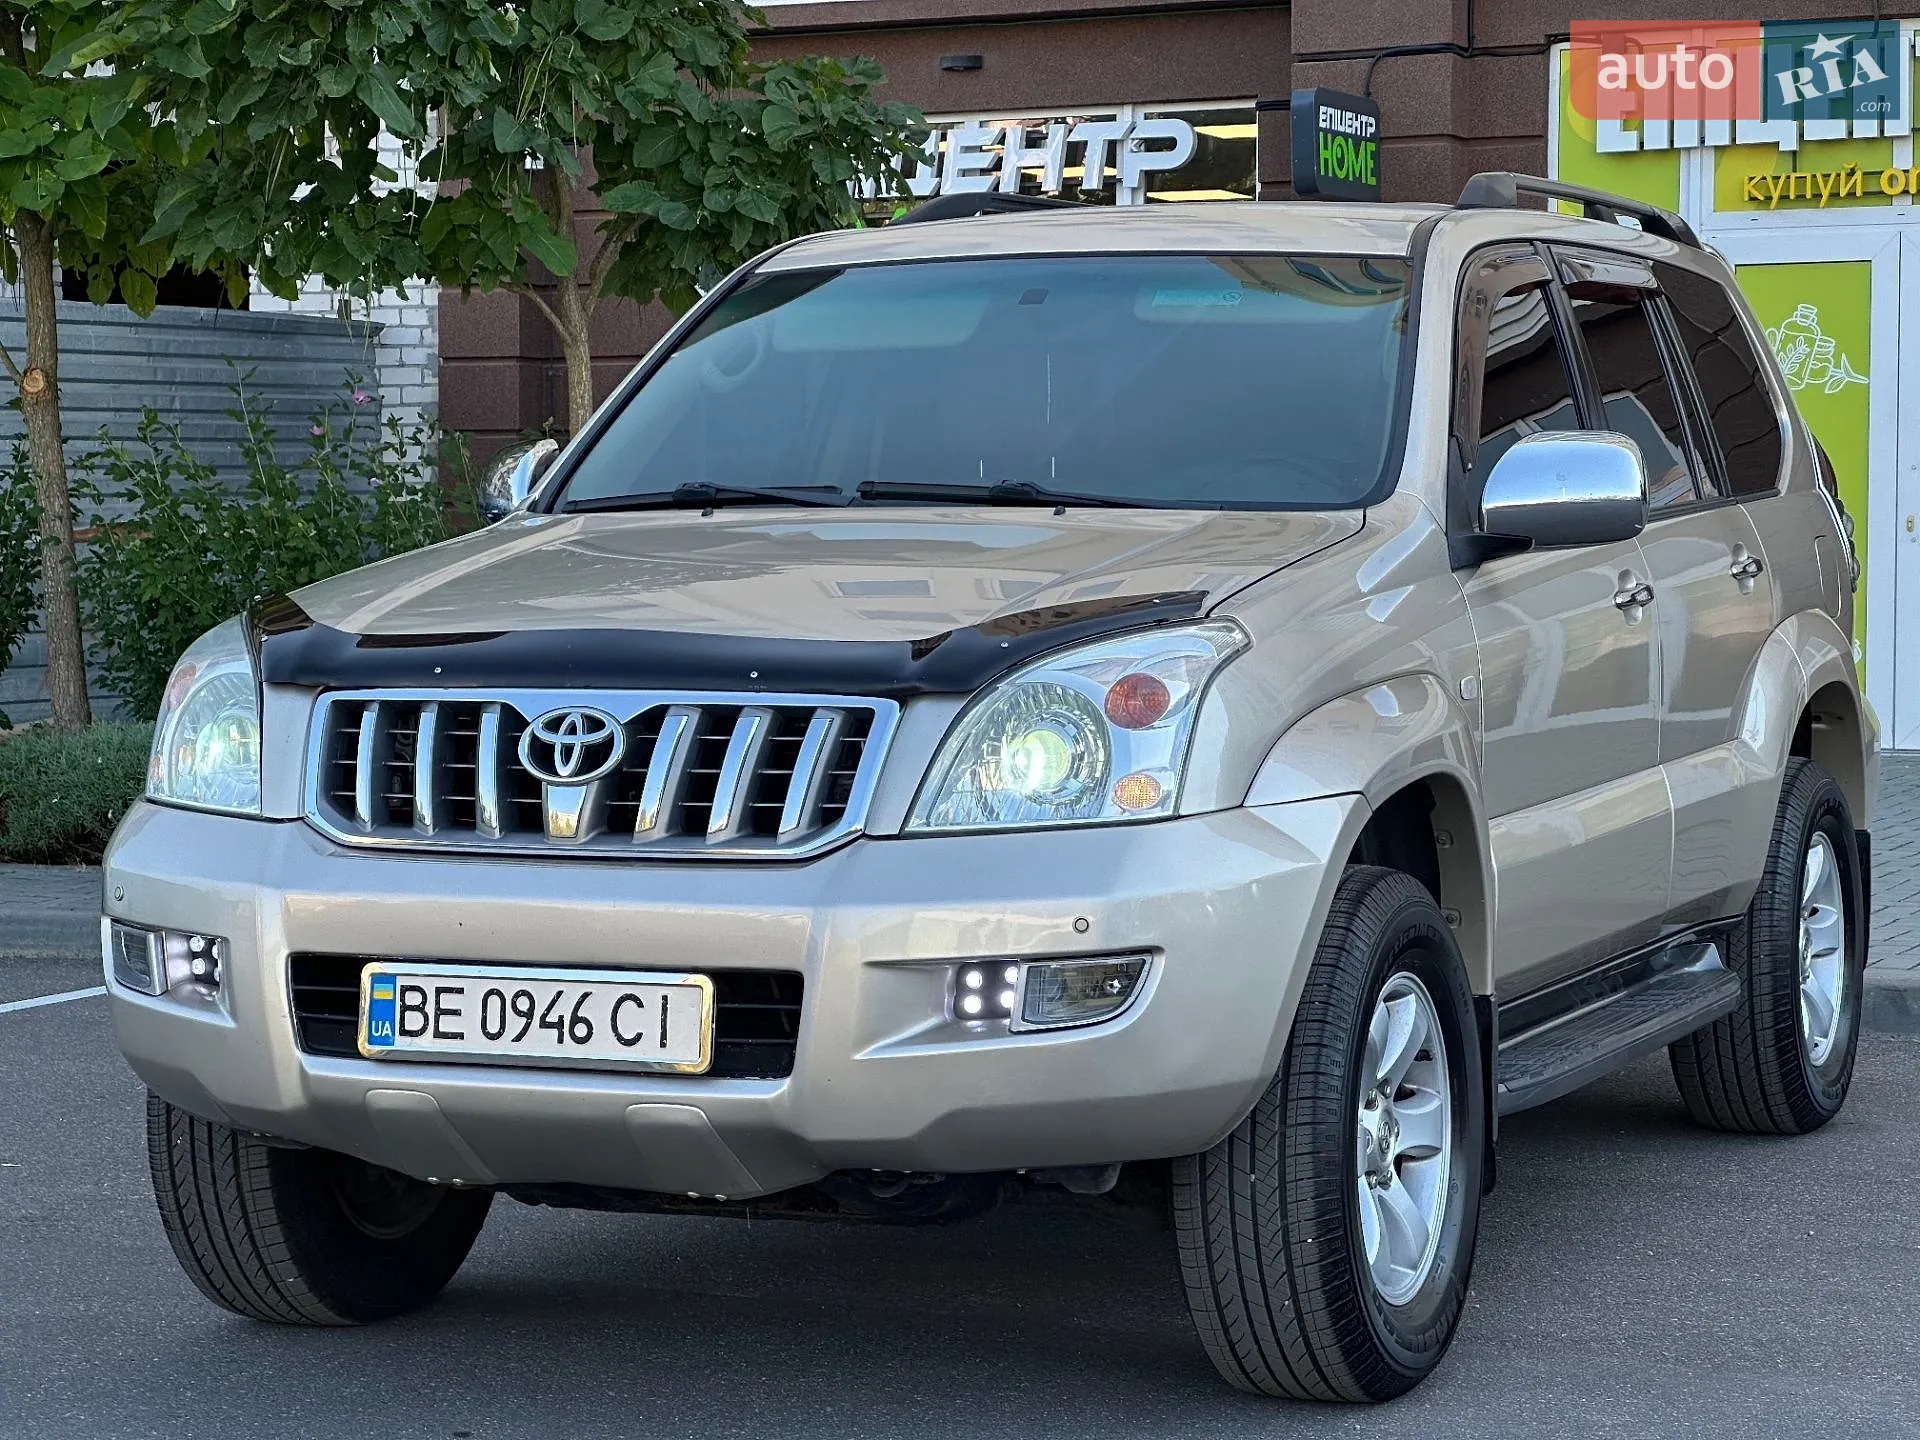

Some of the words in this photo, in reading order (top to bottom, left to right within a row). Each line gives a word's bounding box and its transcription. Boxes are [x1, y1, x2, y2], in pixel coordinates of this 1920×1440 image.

[1319, 105, 1376, 138] ЕПІЦЕНТР
[1319, 131, 1377, 186] HOME
[1743, 161, 1864, 210] купуй
[371, 1020, 392, 1037] UA
[399, 984, 465, 1041] BE
[480, 987, 594, 1045] 0946
[610, 992, 669, 1049] CI
